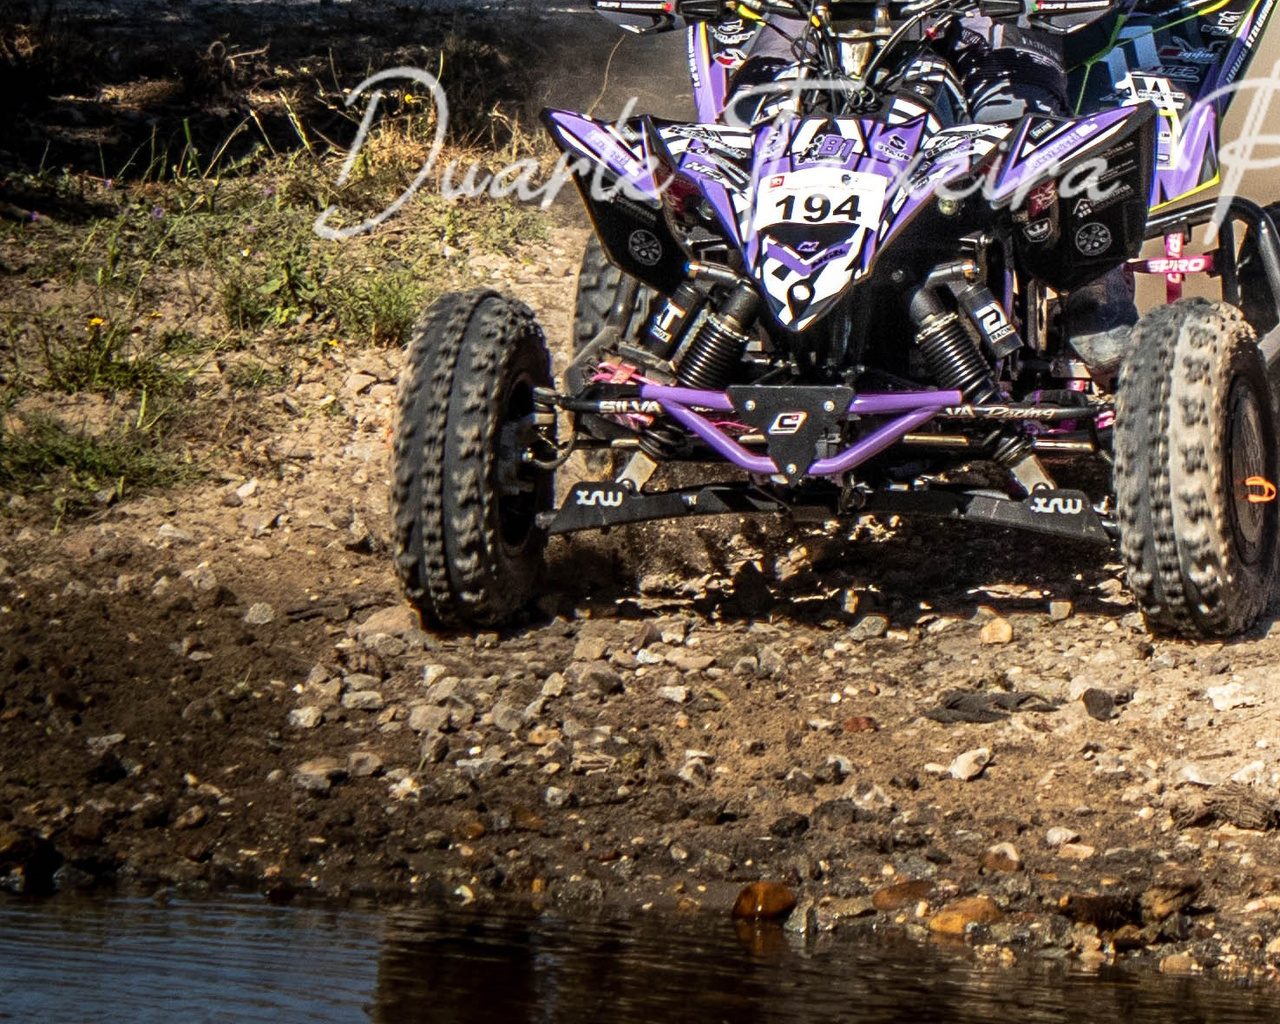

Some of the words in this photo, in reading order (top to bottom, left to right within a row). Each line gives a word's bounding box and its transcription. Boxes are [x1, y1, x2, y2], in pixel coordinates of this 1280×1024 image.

[818, 134, 857, 159] 81
[775, 194, 862, 223] 194
[1148, 256, 1206, 274] SPIRO
[599, 401, 662, 414] SILVA
[987, 406, 1056, 419] Racing
